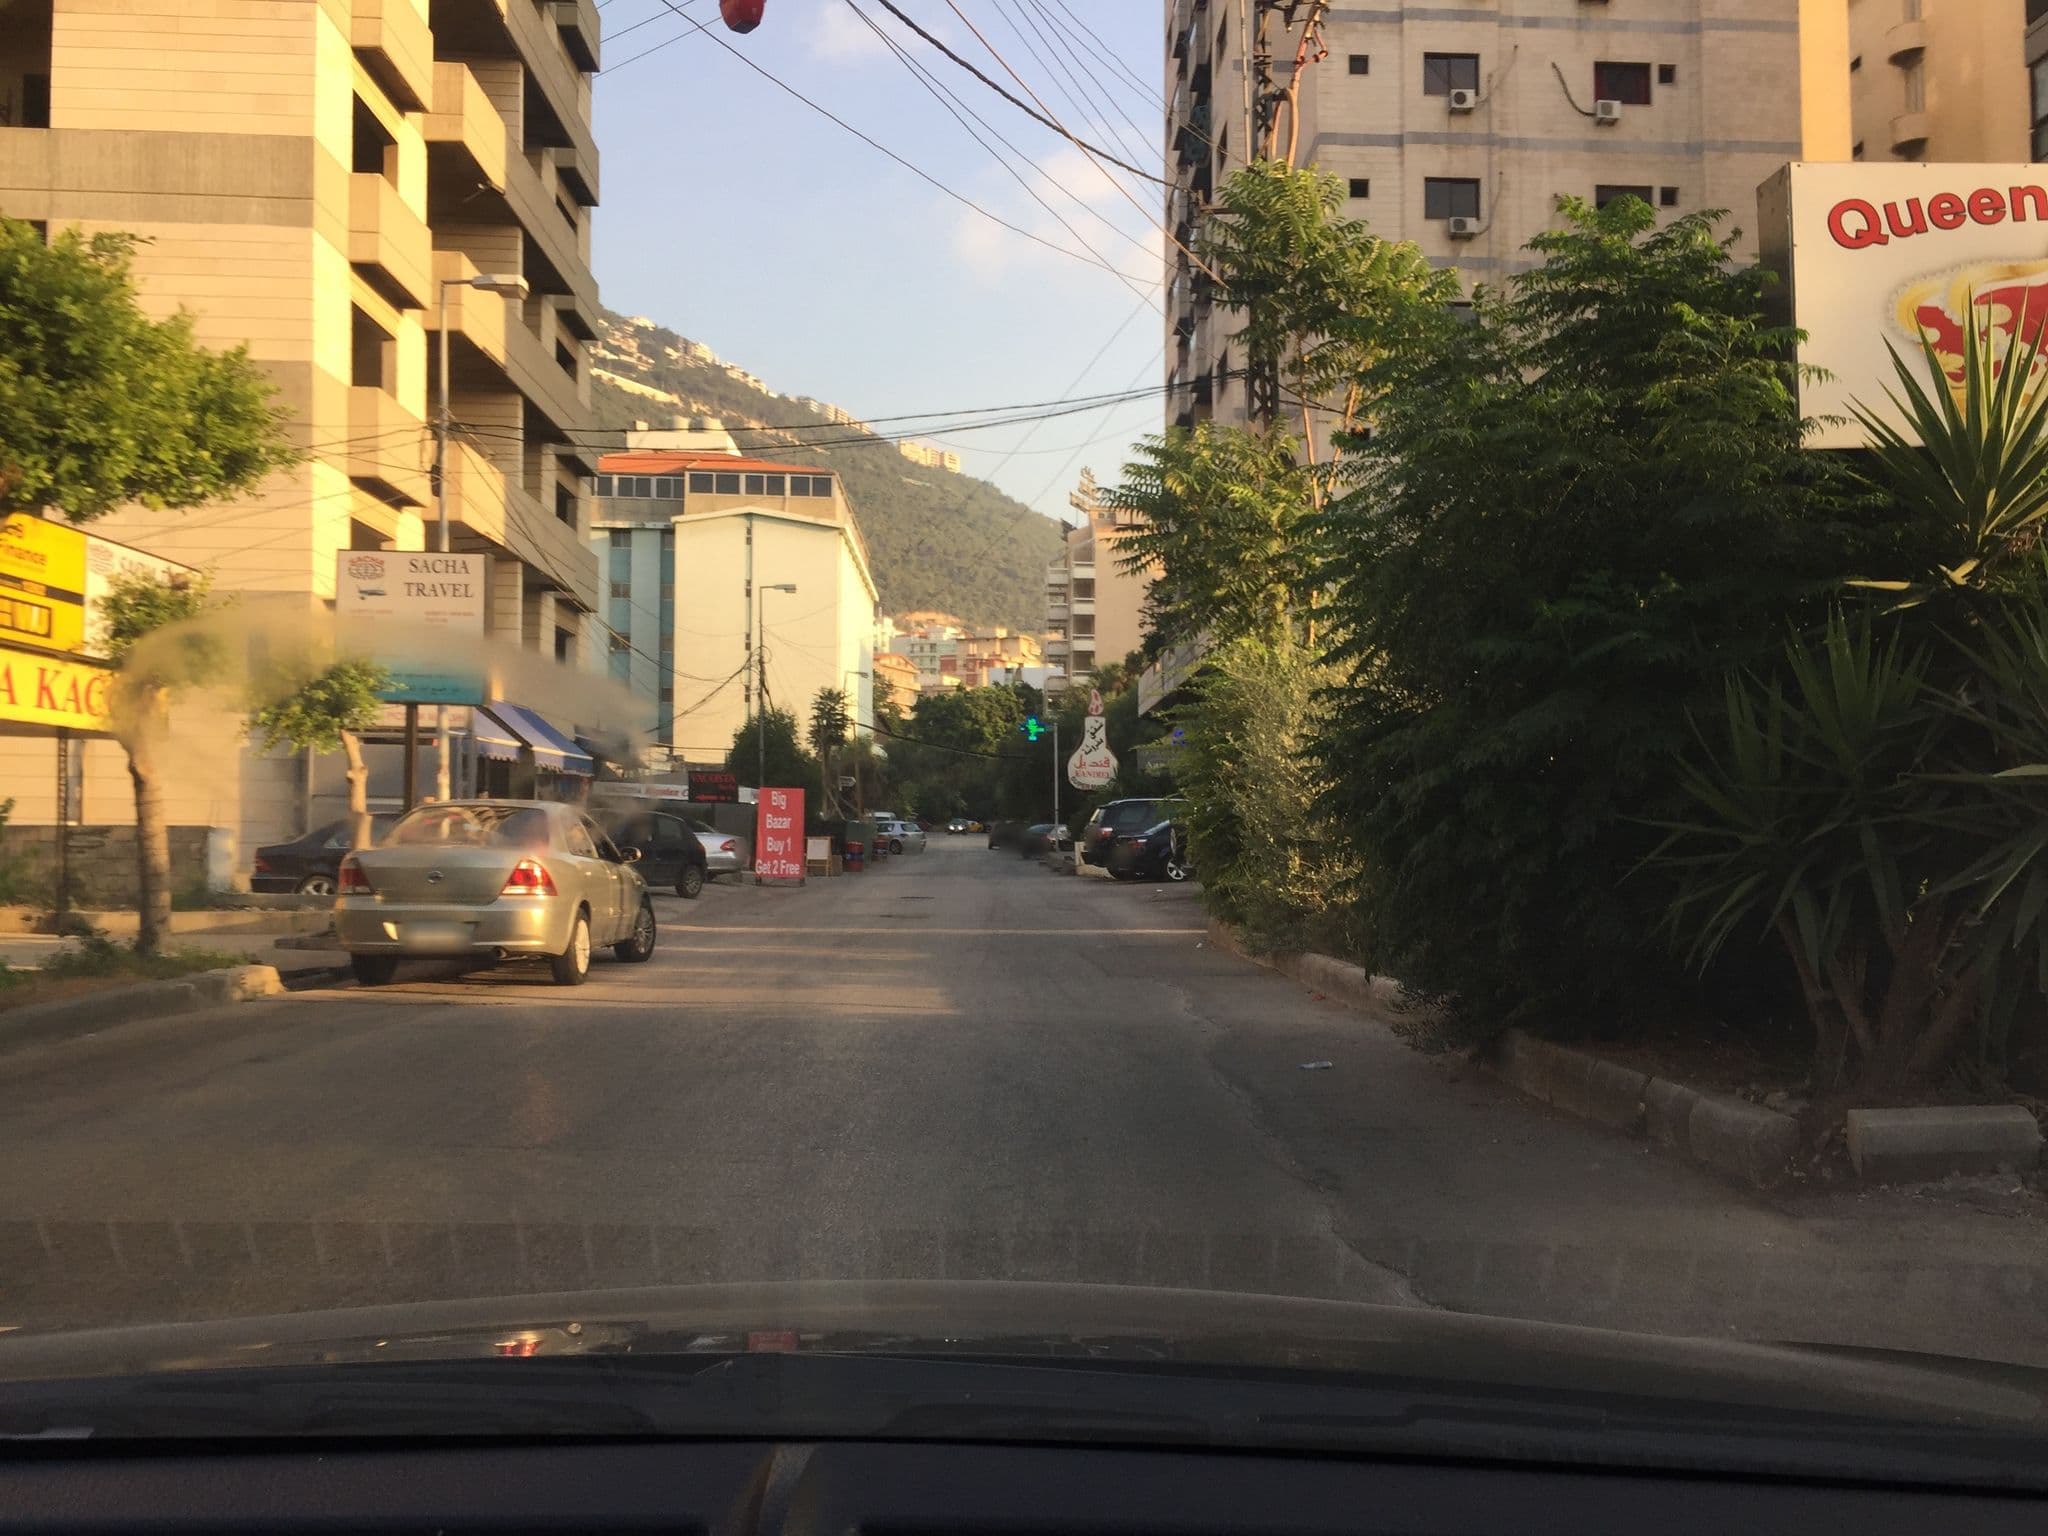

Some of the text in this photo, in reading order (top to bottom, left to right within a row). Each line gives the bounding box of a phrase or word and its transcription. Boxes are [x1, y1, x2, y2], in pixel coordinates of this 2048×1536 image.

[1827, 185, 2048, 249] Queen
[408, 558, 471, 575] SACHA
[405, 582, 474, 598] TRAVEL
[771, 790, 787, 810] Big
[766, 813, 792, 829] Bazar
[767, 836, 792, 856] Buy 1
[755, 859, 801, 875] Get 2 Free
